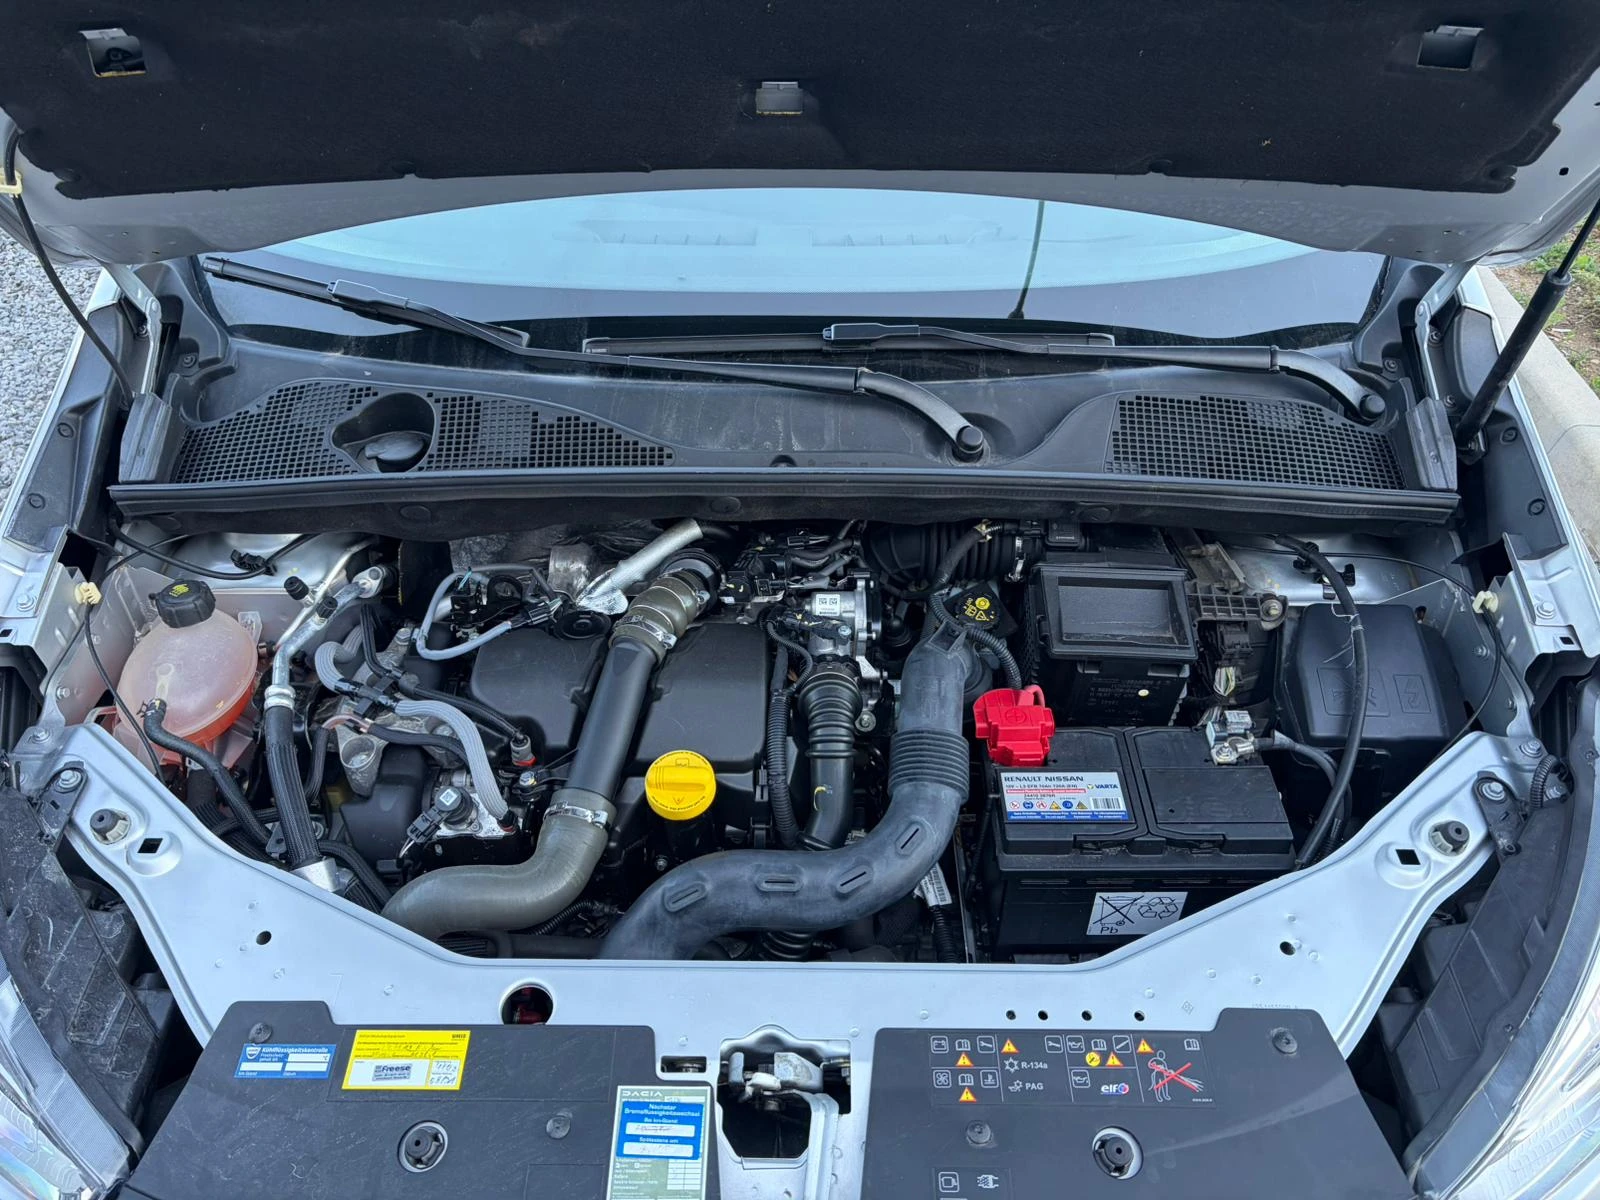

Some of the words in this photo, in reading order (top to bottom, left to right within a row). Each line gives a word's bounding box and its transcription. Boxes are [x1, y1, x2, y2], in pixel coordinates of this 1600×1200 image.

[1100, 926, 1119, 934] Pb
[1021, 1061, 1048, 1069] R-134a
[1025, 1083, 1044, 1091] PAG
[1100, 1083, 1119, 1093] elf
